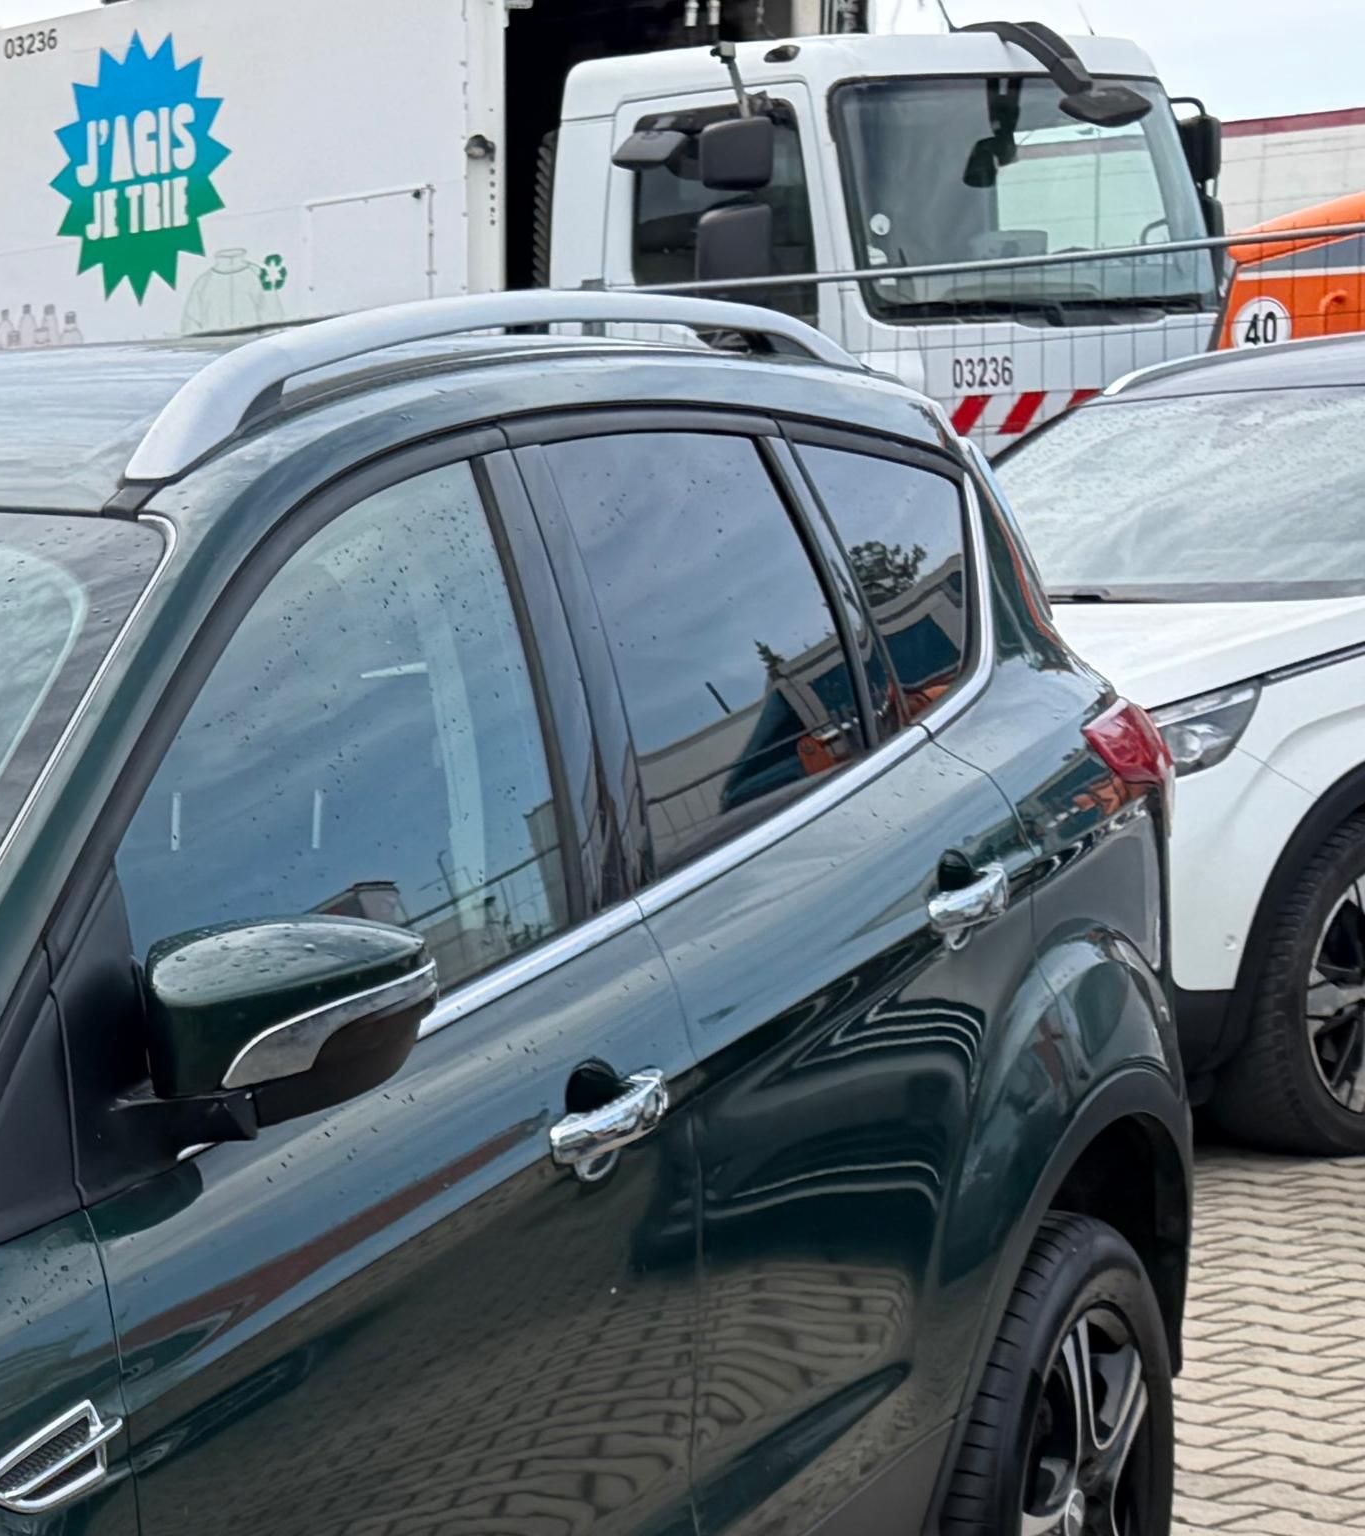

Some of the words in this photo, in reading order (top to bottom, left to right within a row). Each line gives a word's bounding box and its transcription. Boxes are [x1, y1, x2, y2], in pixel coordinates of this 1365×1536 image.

[4, 28, 57, 59] 03236
[75, 103, 196, 187] J'AGIS
[85, 188, 119, 240] JE
[125, 176, 189, 234] TRIE
[1245, 311, 1277, 345] 40
[953, 356, 1013, 388] 03236
